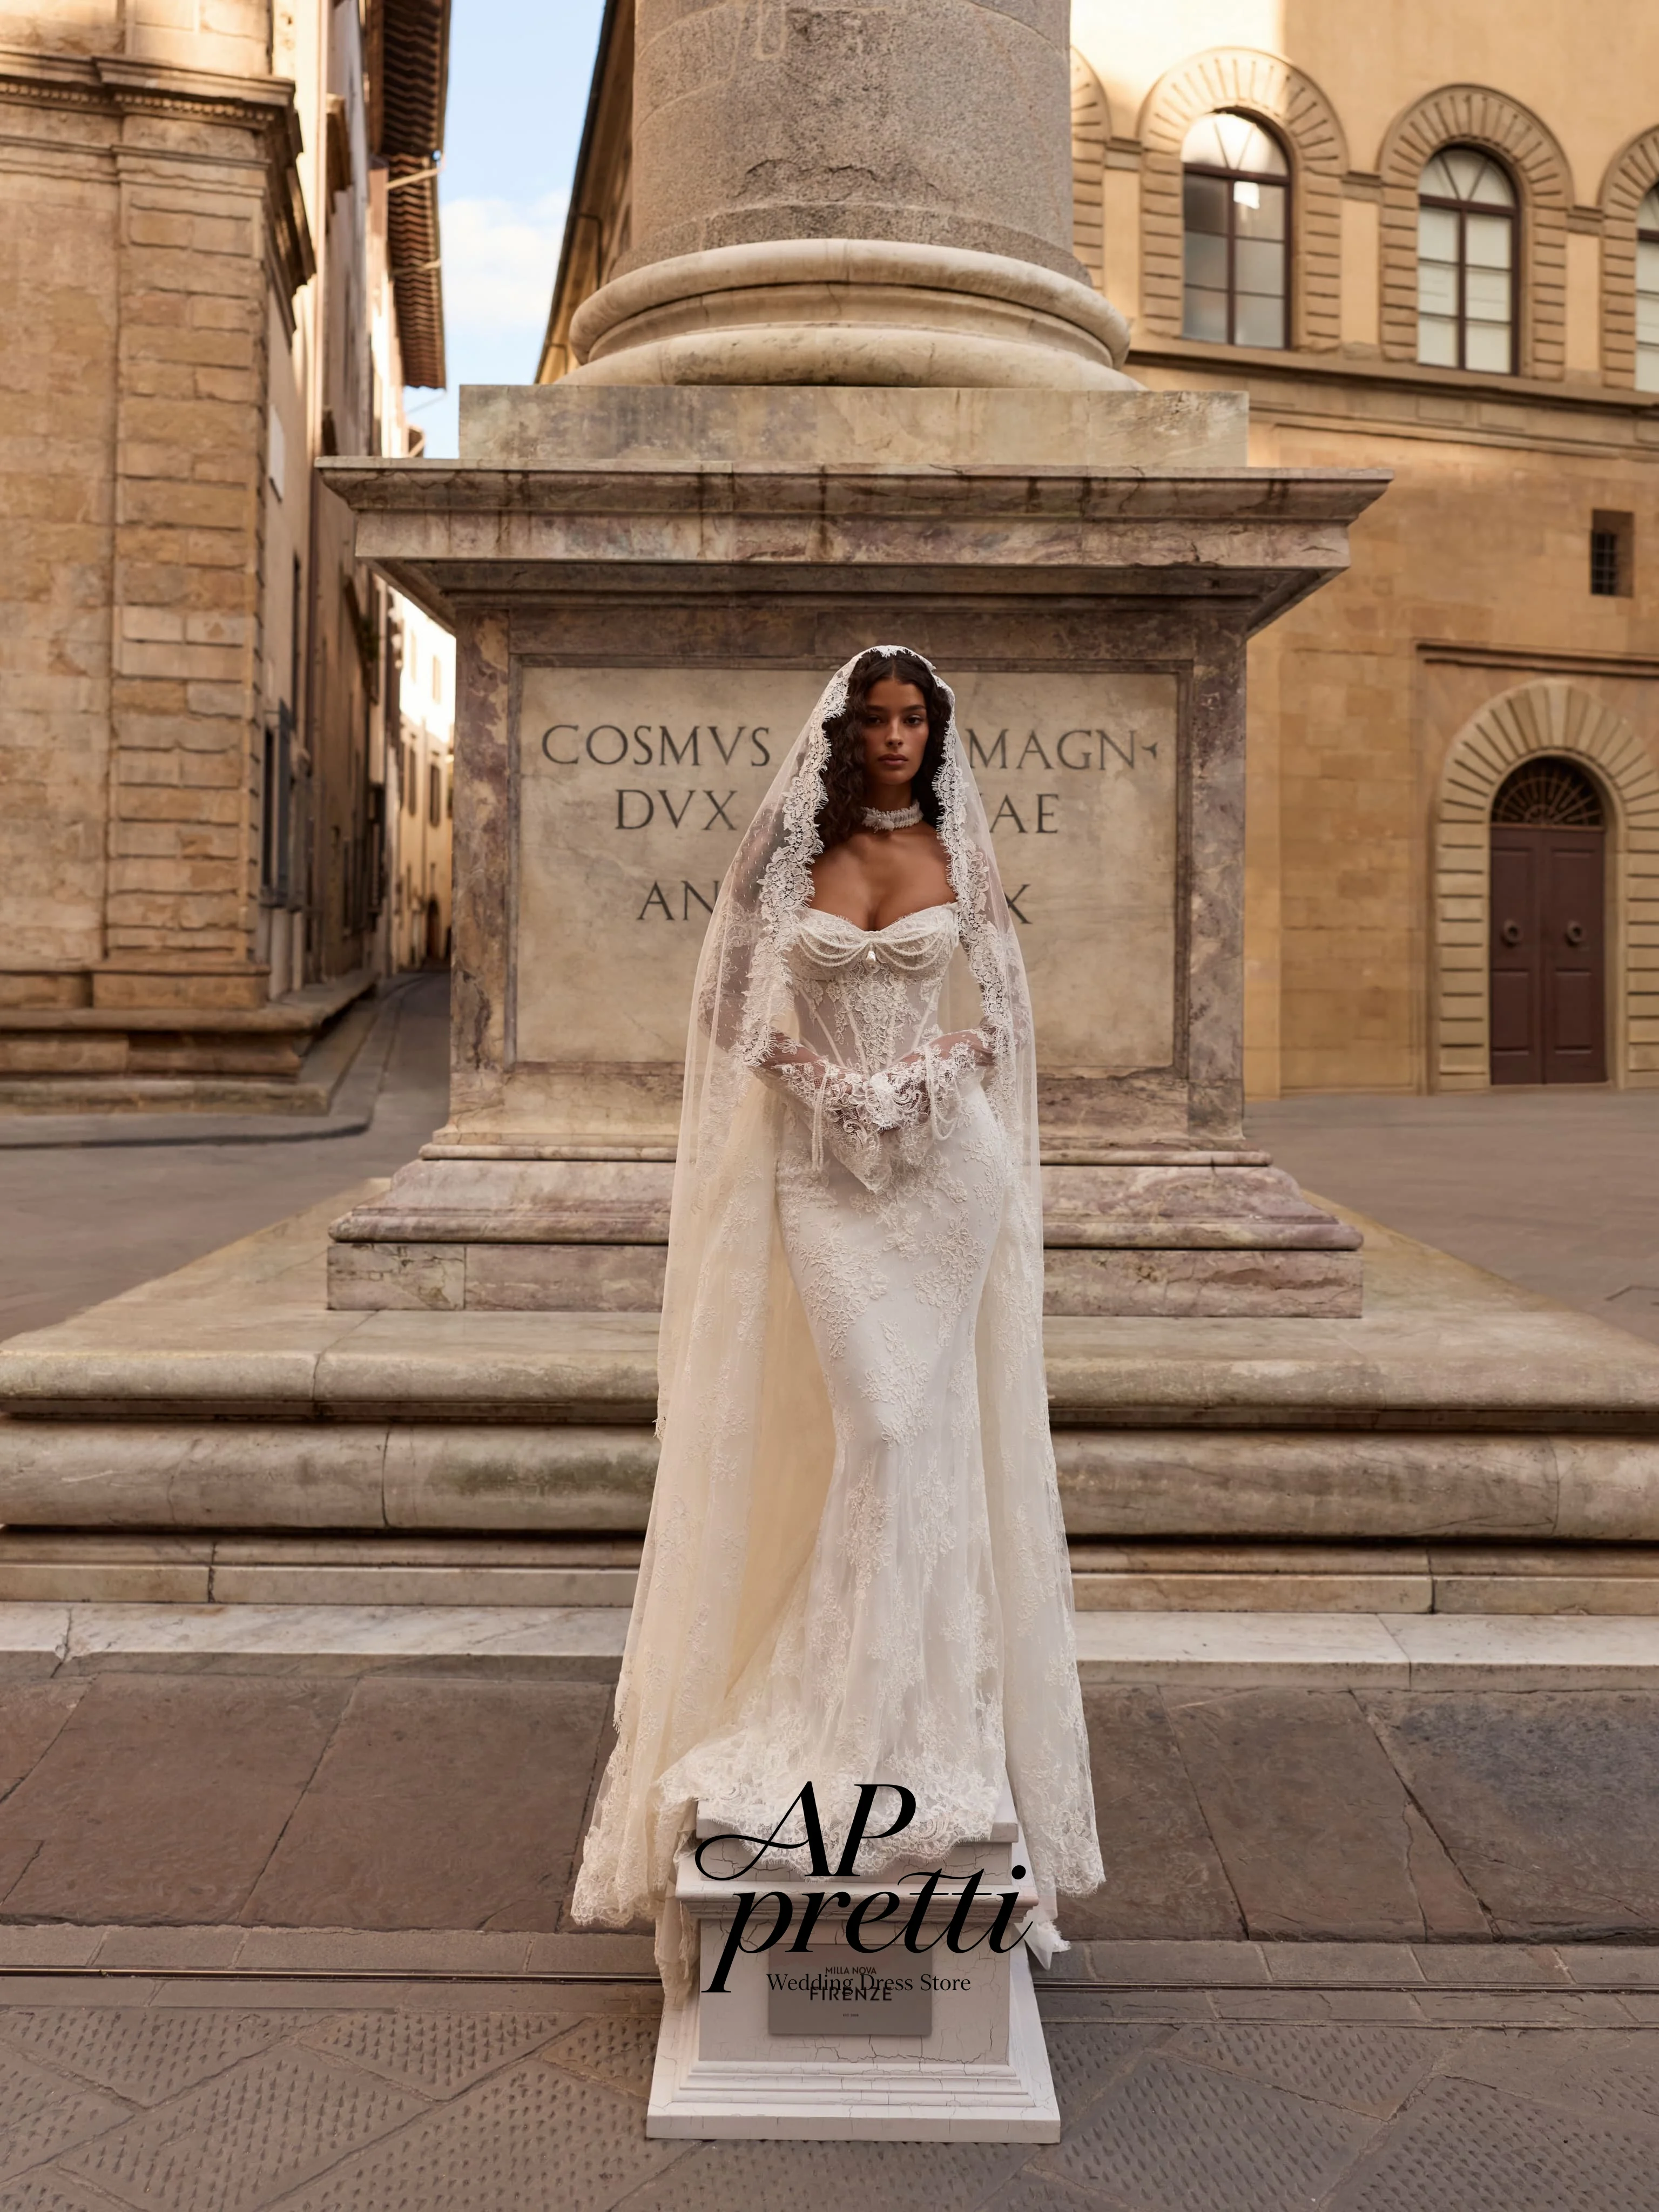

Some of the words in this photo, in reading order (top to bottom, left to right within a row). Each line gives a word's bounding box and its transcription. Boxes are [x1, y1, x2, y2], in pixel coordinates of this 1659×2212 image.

[542, 724, 771, 767] COSMVS
[615, 789, 738, 831] DVX
[825, 1966, 849, 1974] MILLA
[852, 1966, 877, 1974] NOVA
[810, 1986, 892, 2001] FIRENZE
